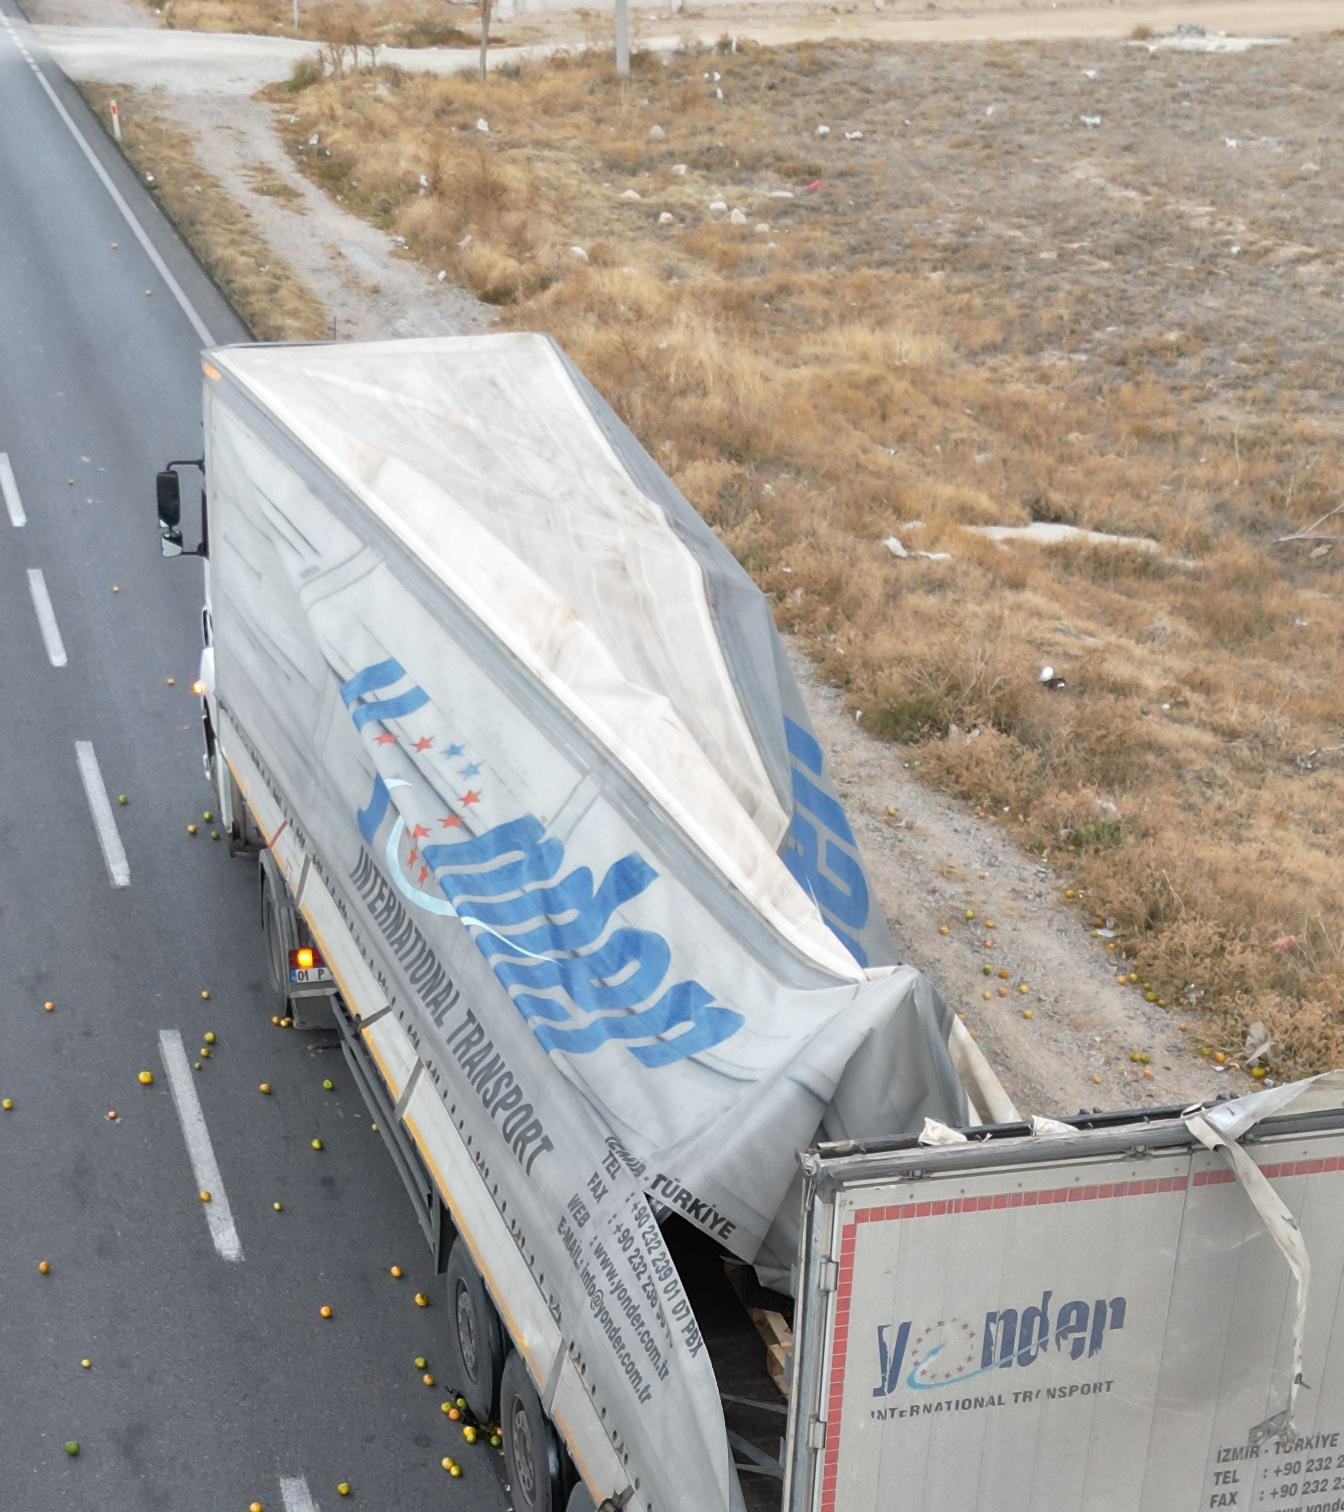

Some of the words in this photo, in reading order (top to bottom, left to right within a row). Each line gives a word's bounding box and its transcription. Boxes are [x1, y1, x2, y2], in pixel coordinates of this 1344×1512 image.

[350, 846, 460, 1028] INTERNATIONAL
[446, 1008, 554, 1176] TRANSPORT
[602, 1150, 621, 1180] TEL
[631, 1201, 651, 1229] +90
[650, 1173, 736, 1240] TÜRKİYE
[587, 1171, 608, 1204] FAX
[614, 1223, 635, 1252] +90
[627, 1248, 648, 1281] 232
[642, 1225, 662, 1255] 232
[652, 1252, 673, 1281] 239
[567, 1193, 591, 1228] WEB
[594, 1242, 669, 1381] www.yonder.com.tr
[664, 1279, 681, 1302] 01
[672, 1299, 691, 1322] 07
[580, 1262, 653, 1404] info@yonder.com.tr
[681, 1319, 703, 1358] PBX
[1214, 1470, 1240, 1486] TEL
[1274, 1461, 1301, 1477] +90
[1306, 1457, 1332, 1472] 232
[1209, 1491, 1238, 1508] FAX
[1270, 1483, 1298, 1500] +90
[1302, 1479, 1328, 1495] 232
